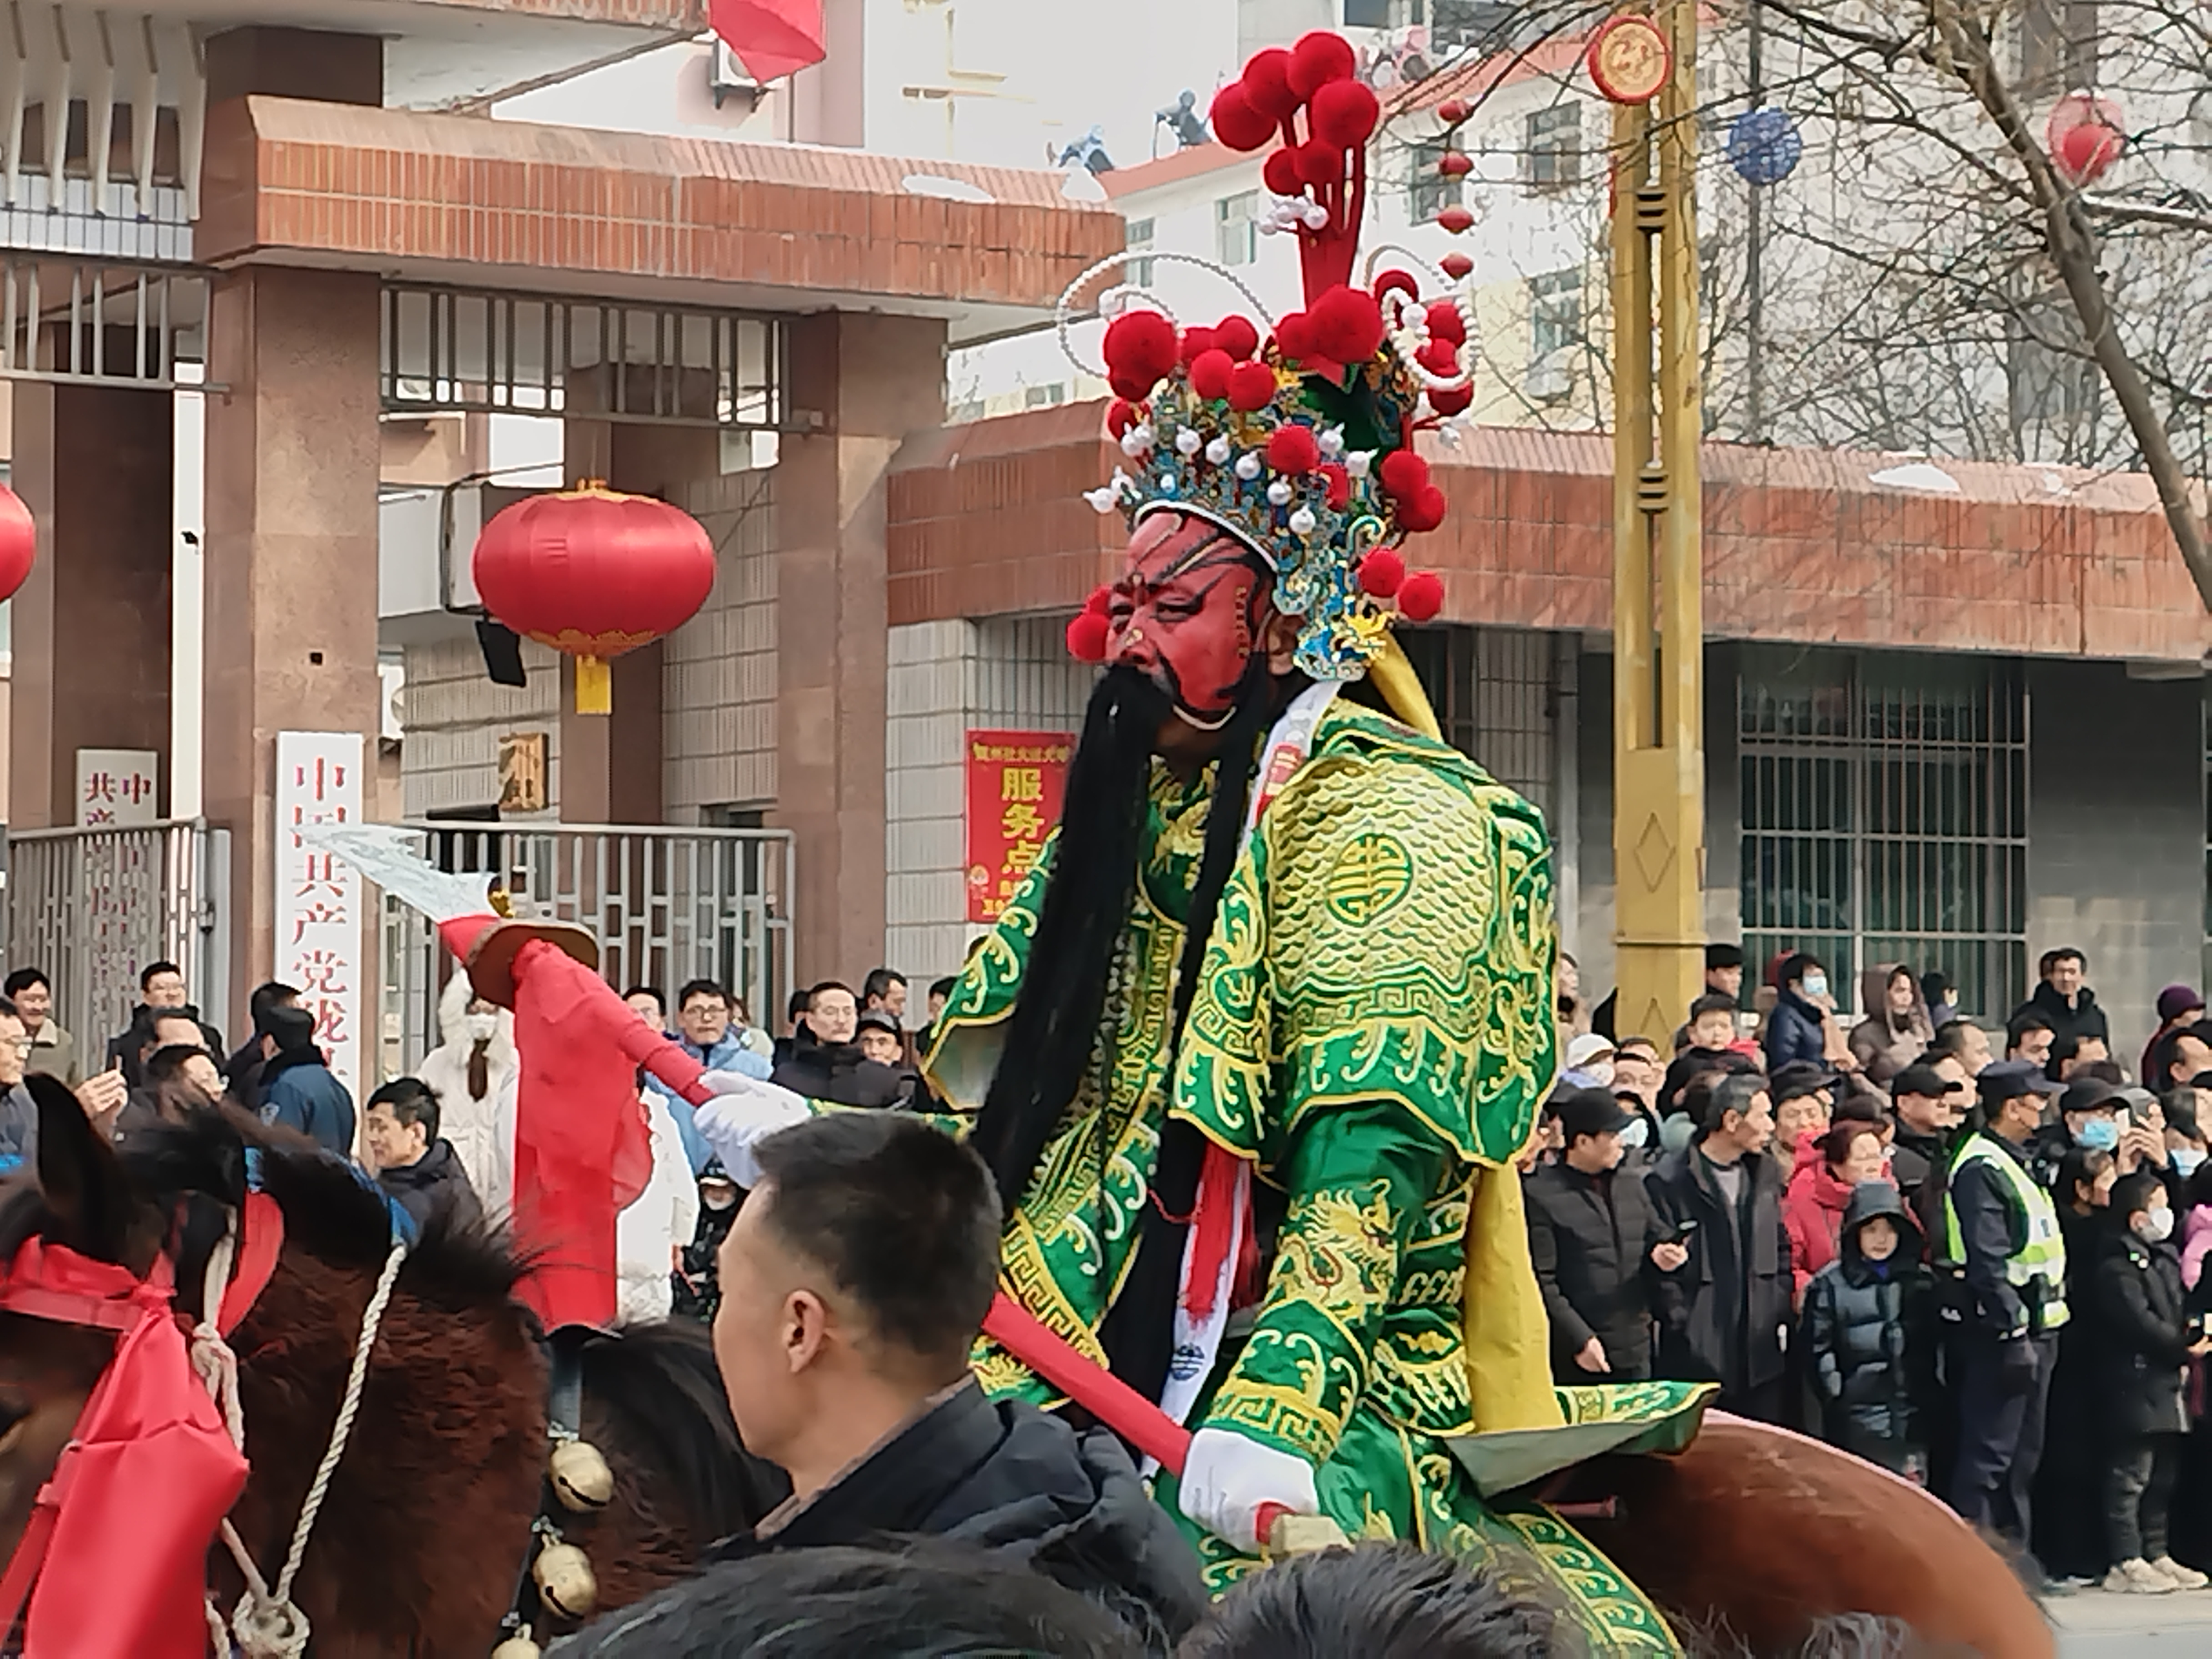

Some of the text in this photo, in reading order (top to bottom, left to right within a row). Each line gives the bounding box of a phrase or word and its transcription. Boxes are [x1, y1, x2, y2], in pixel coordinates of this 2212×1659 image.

[292, 756, 349, 1076] 中国共产党陇
[1001, 767, 1044, 874] 服务点
